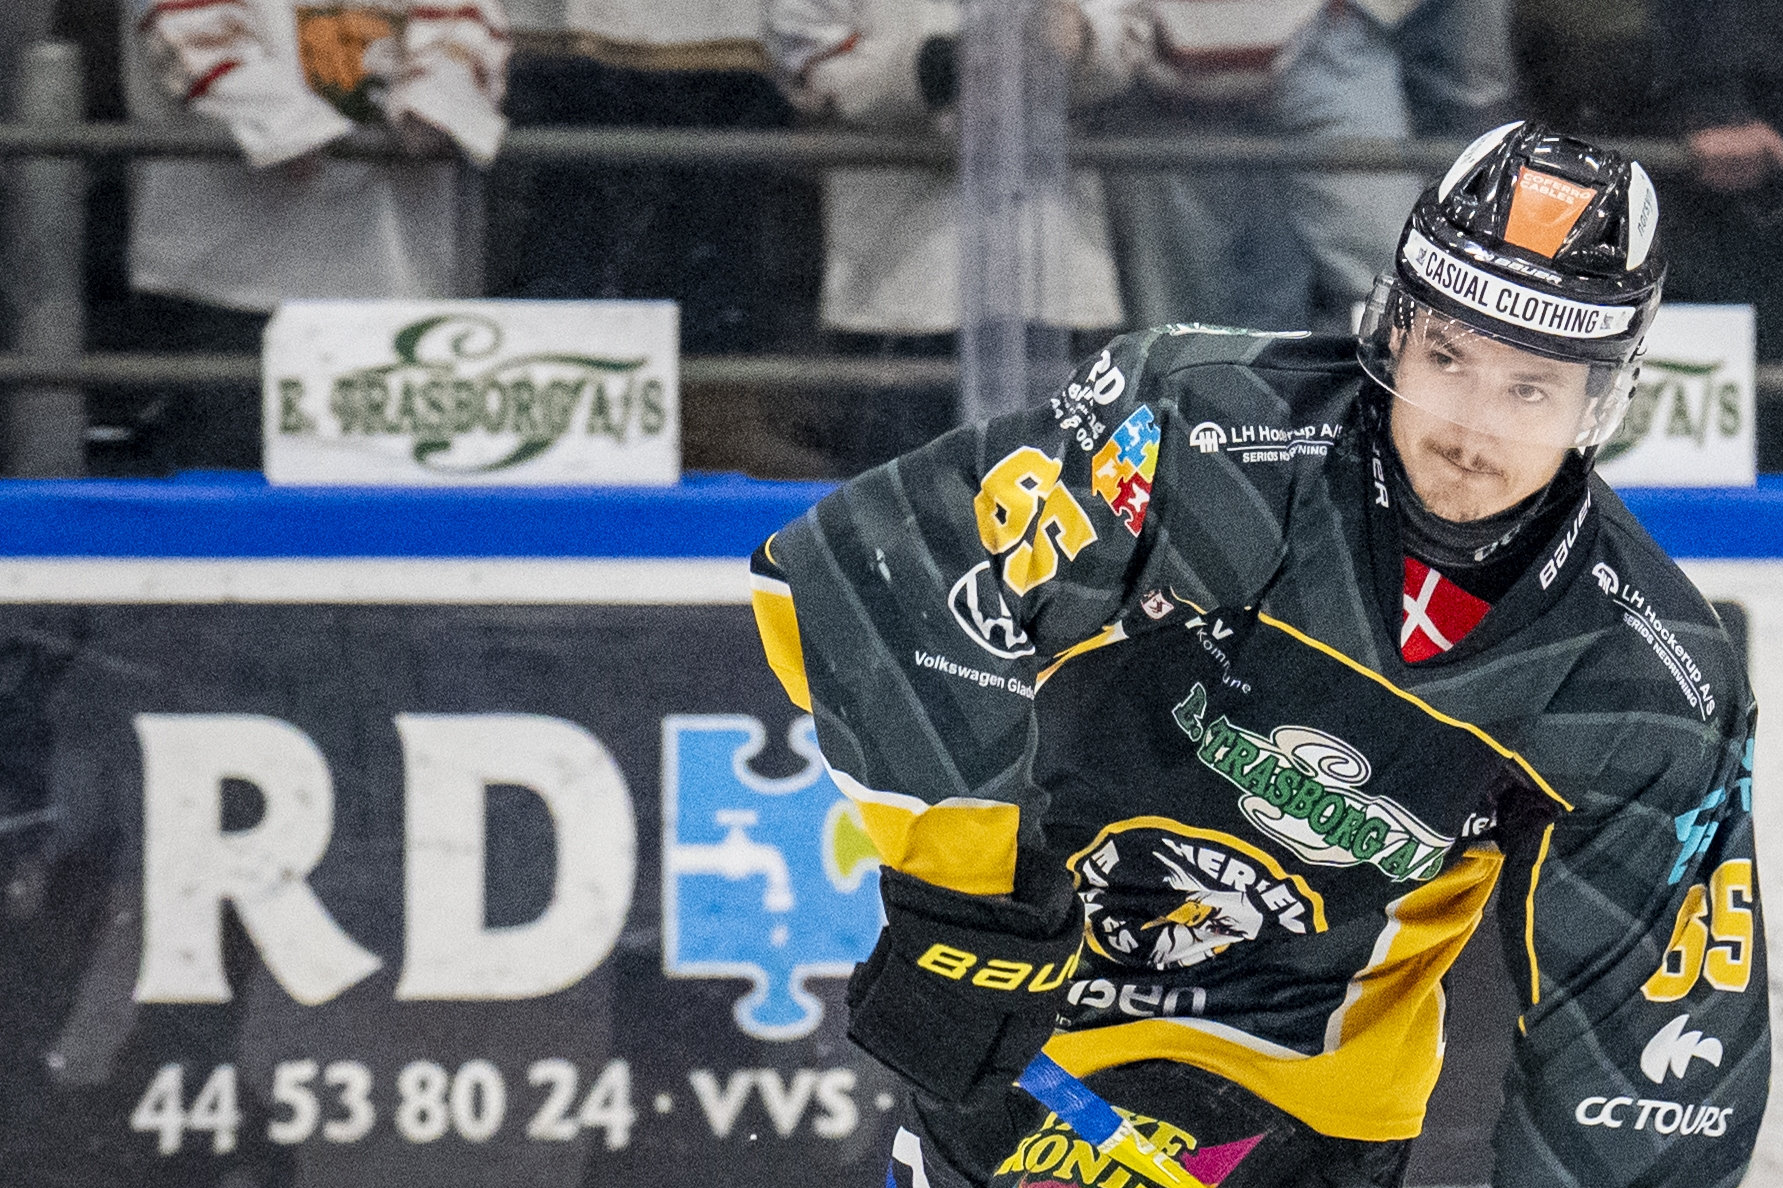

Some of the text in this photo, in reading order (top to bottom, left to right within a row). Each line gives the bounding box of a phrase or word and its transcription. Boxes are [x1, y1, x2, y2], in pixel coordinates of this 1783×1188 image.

[1520, 180, 1575, 206] CABLES
[1425, 250, 1601, 334] CASUAL CLOTHING
[1231, 424, 1255, 444] LH
[914, 650, 1005, 689] Volkswagen
[1621, 584, 1645, 609] LH
[1644, 604, 1702, 684] Hockerup
[1201, 718, 1393, 861] TRASBORG
[1640, 857, 1754, 1003] 65
[130, 1058, 859, 1156] 44 53 80 24 VVS
[1575, 1096, 1734, 1138] CC TOURS
